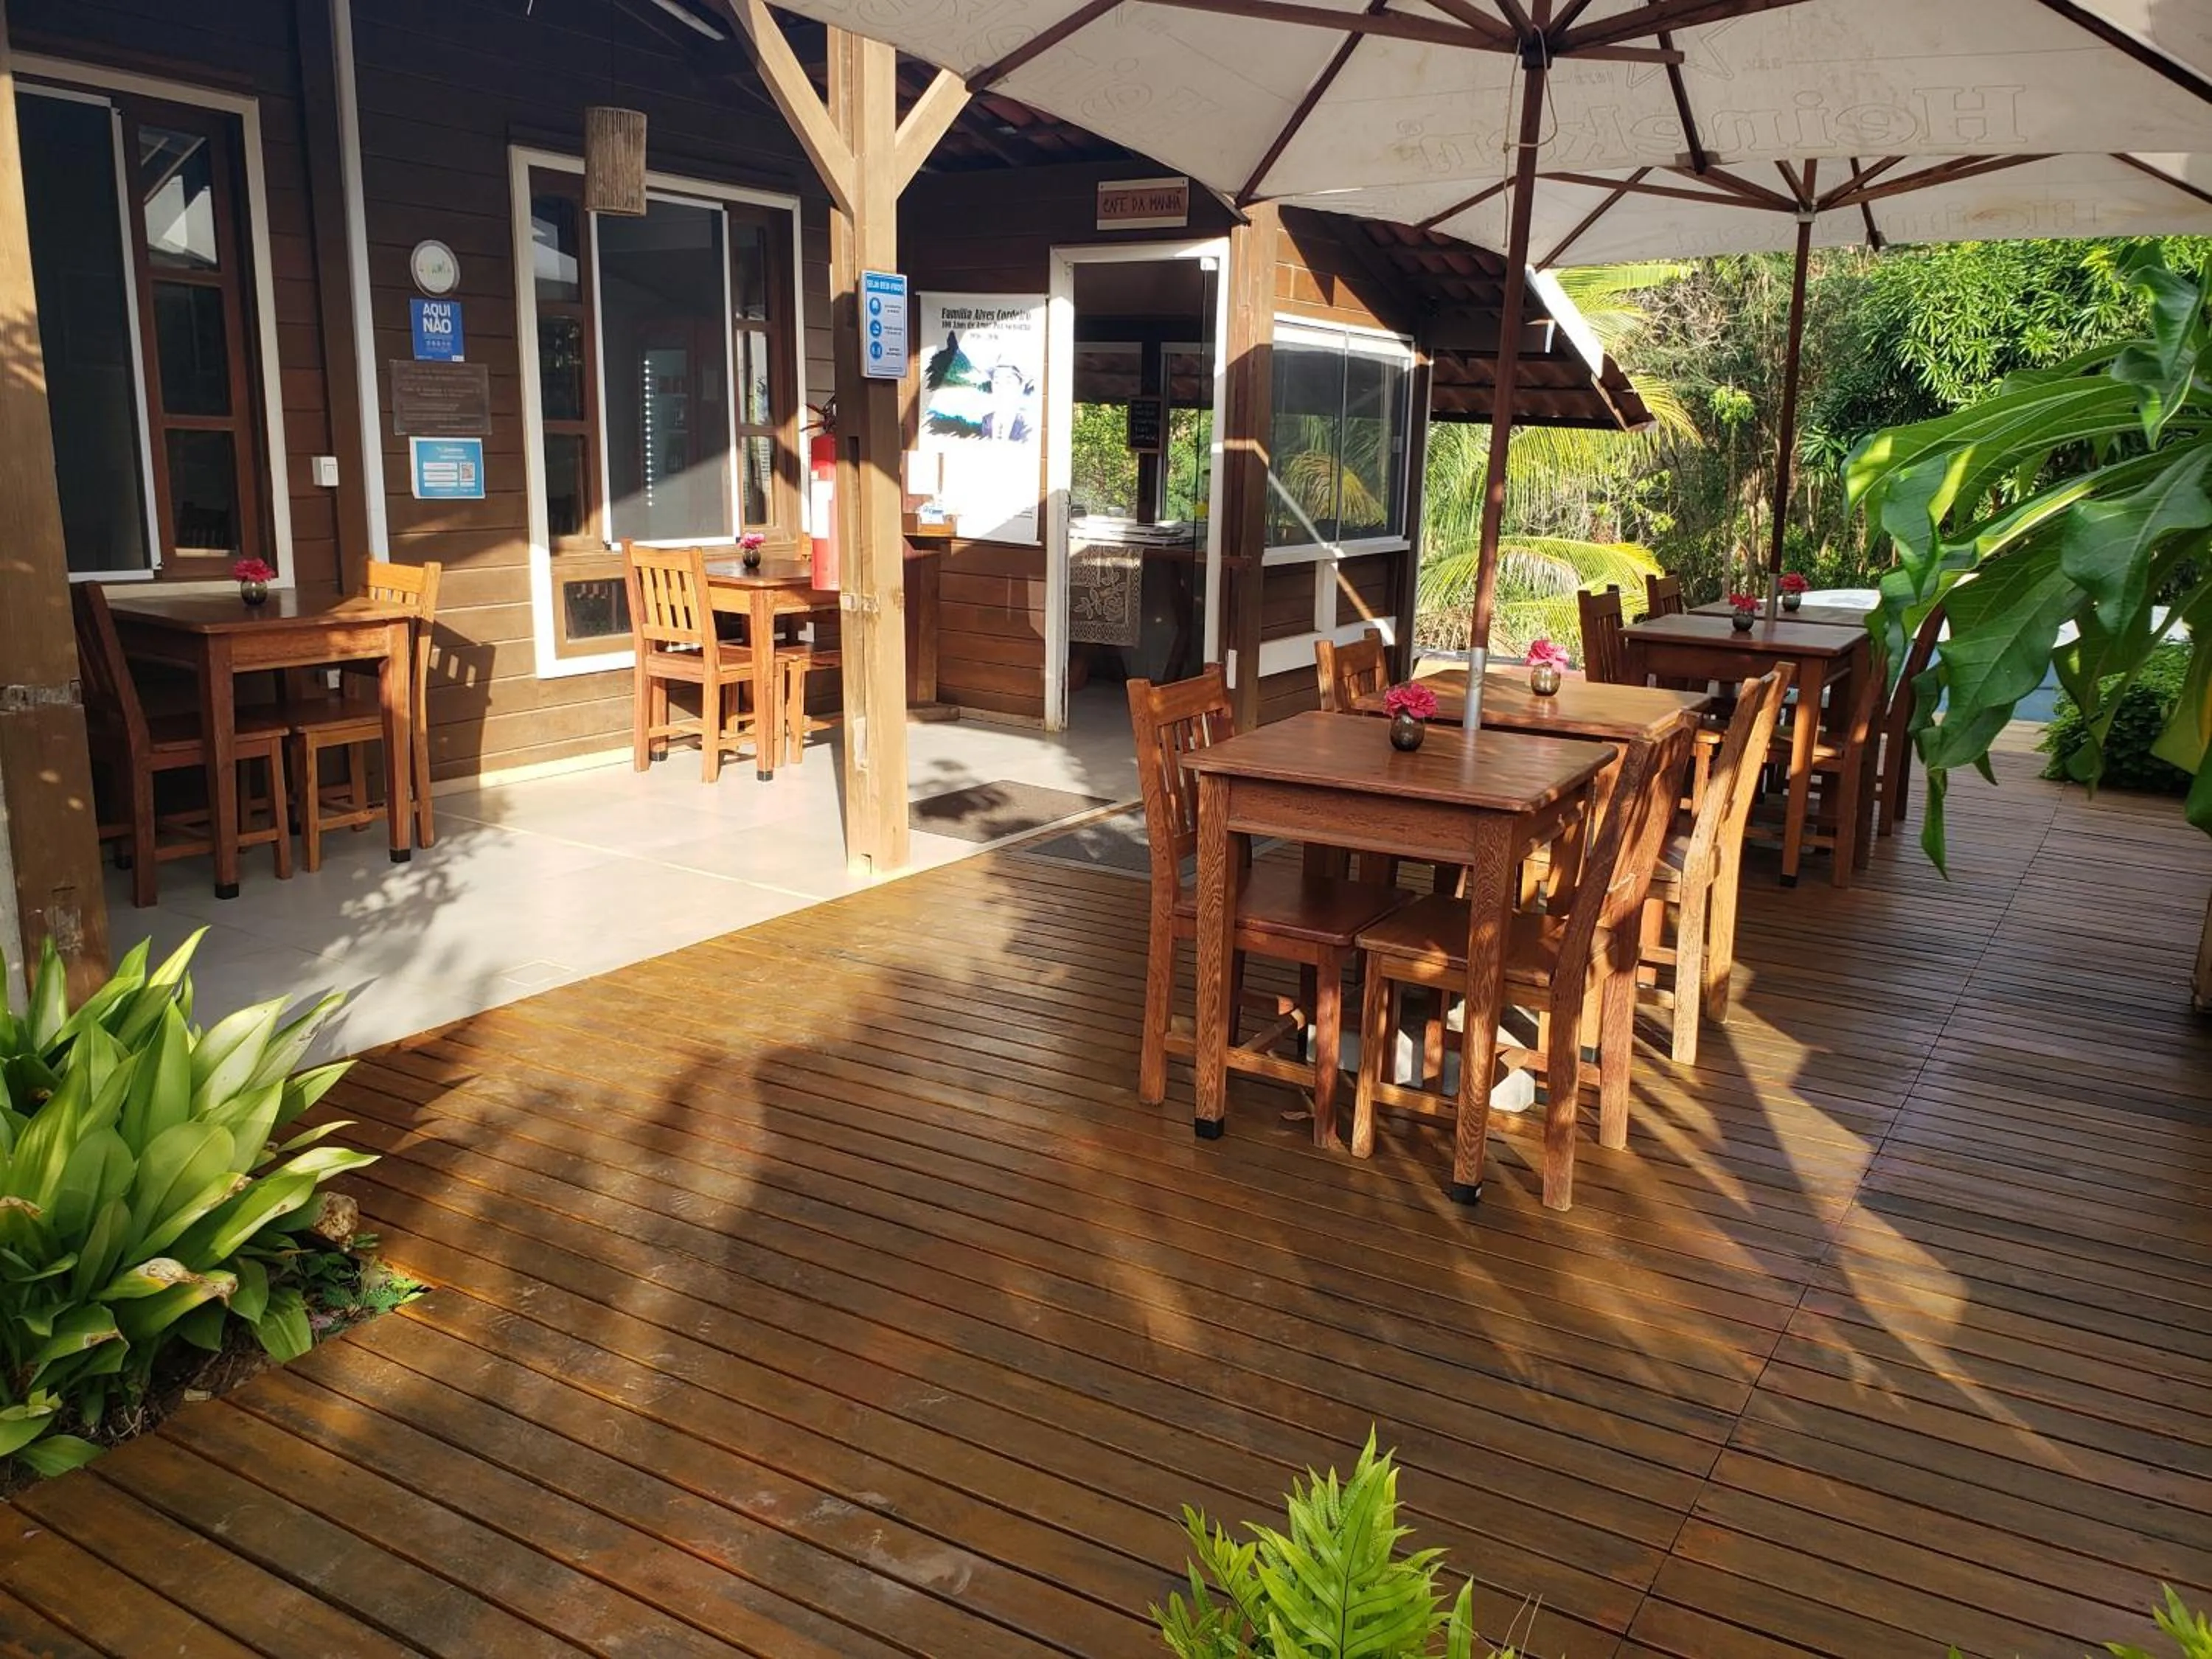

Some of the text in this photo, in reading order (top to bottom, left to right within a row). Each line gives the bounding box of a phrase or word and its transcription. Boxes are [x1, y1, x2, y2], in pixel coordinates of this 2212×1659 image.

[1132, 195, 1145, 212] DA
[423, 302, 451, 318] AQUI
[973, 308, 995, 321] Alves
